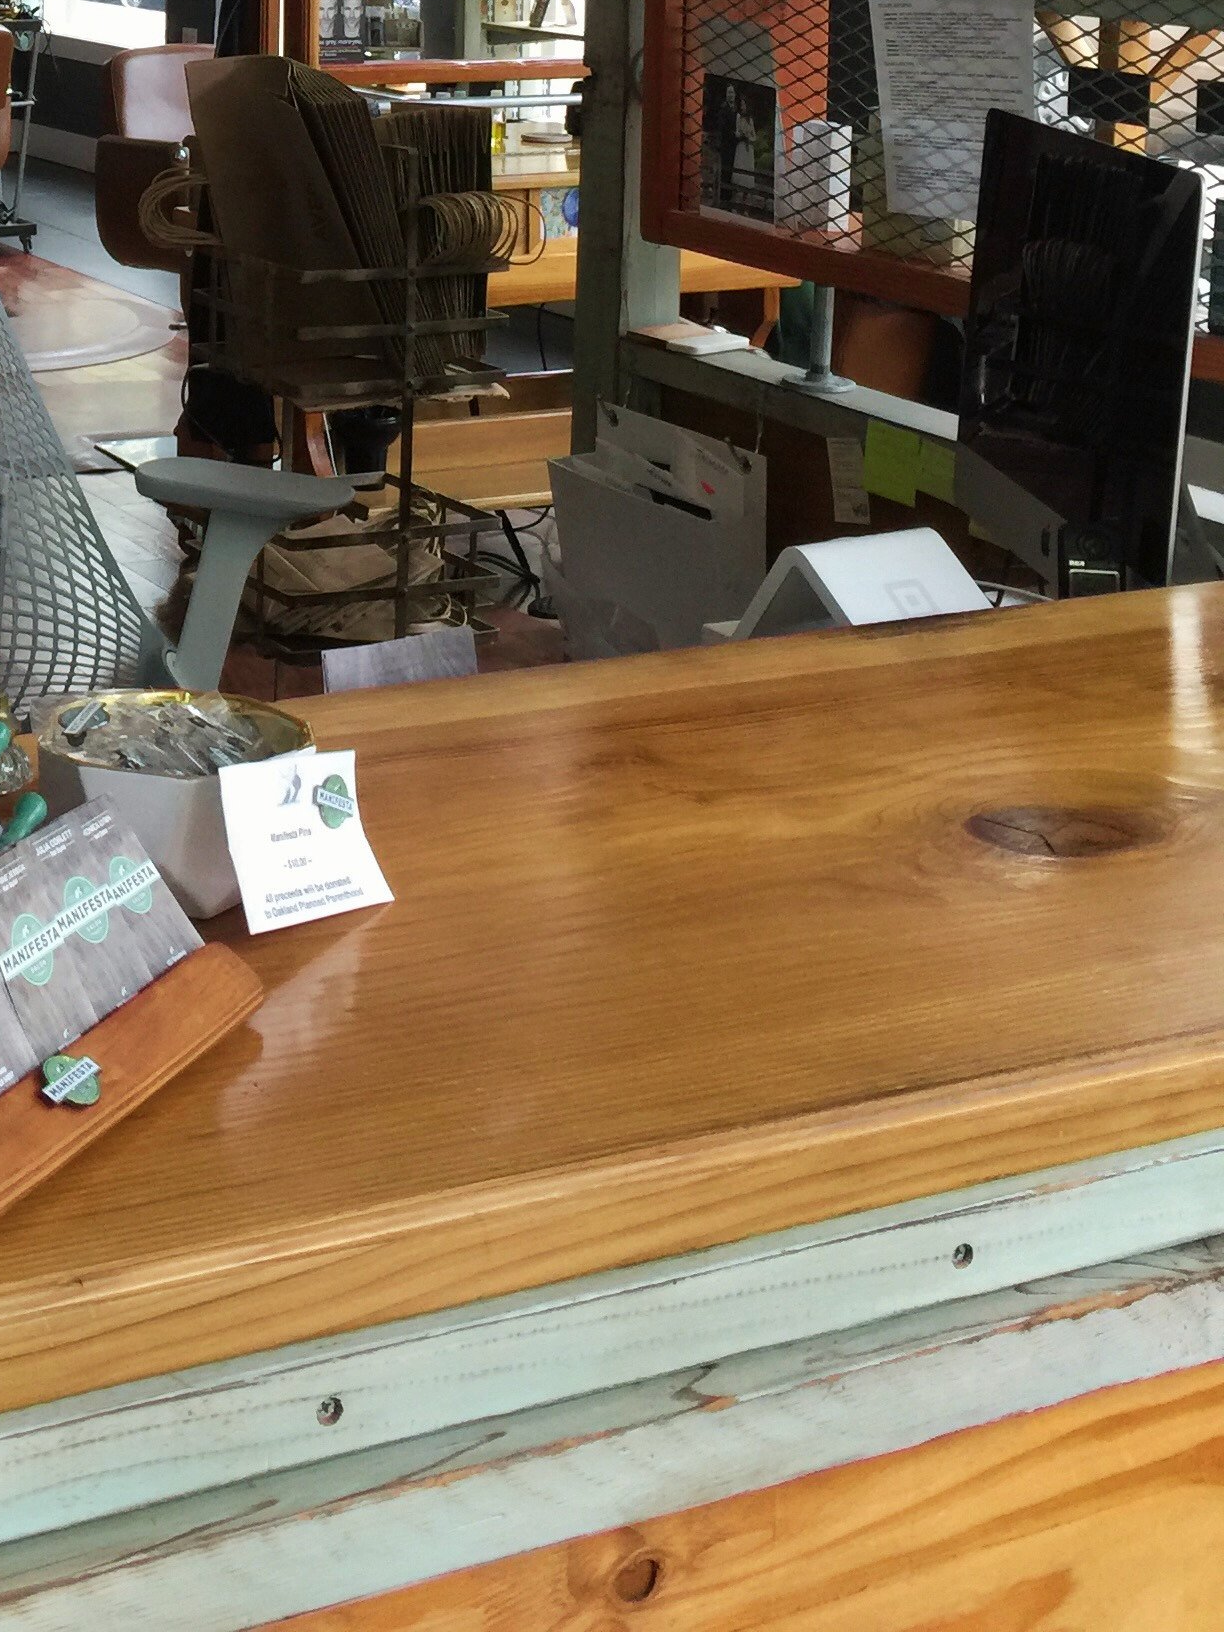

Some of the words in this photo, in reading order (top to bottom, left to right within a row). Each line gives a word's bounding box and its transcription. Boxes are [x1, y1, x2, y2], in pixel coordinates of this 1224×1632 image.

[56, 888, 116, 933] MANIFESTA
[2, 928, 62, 974] MANIFESTA
[49, 1061, 94, 1098] MANIFESTA
